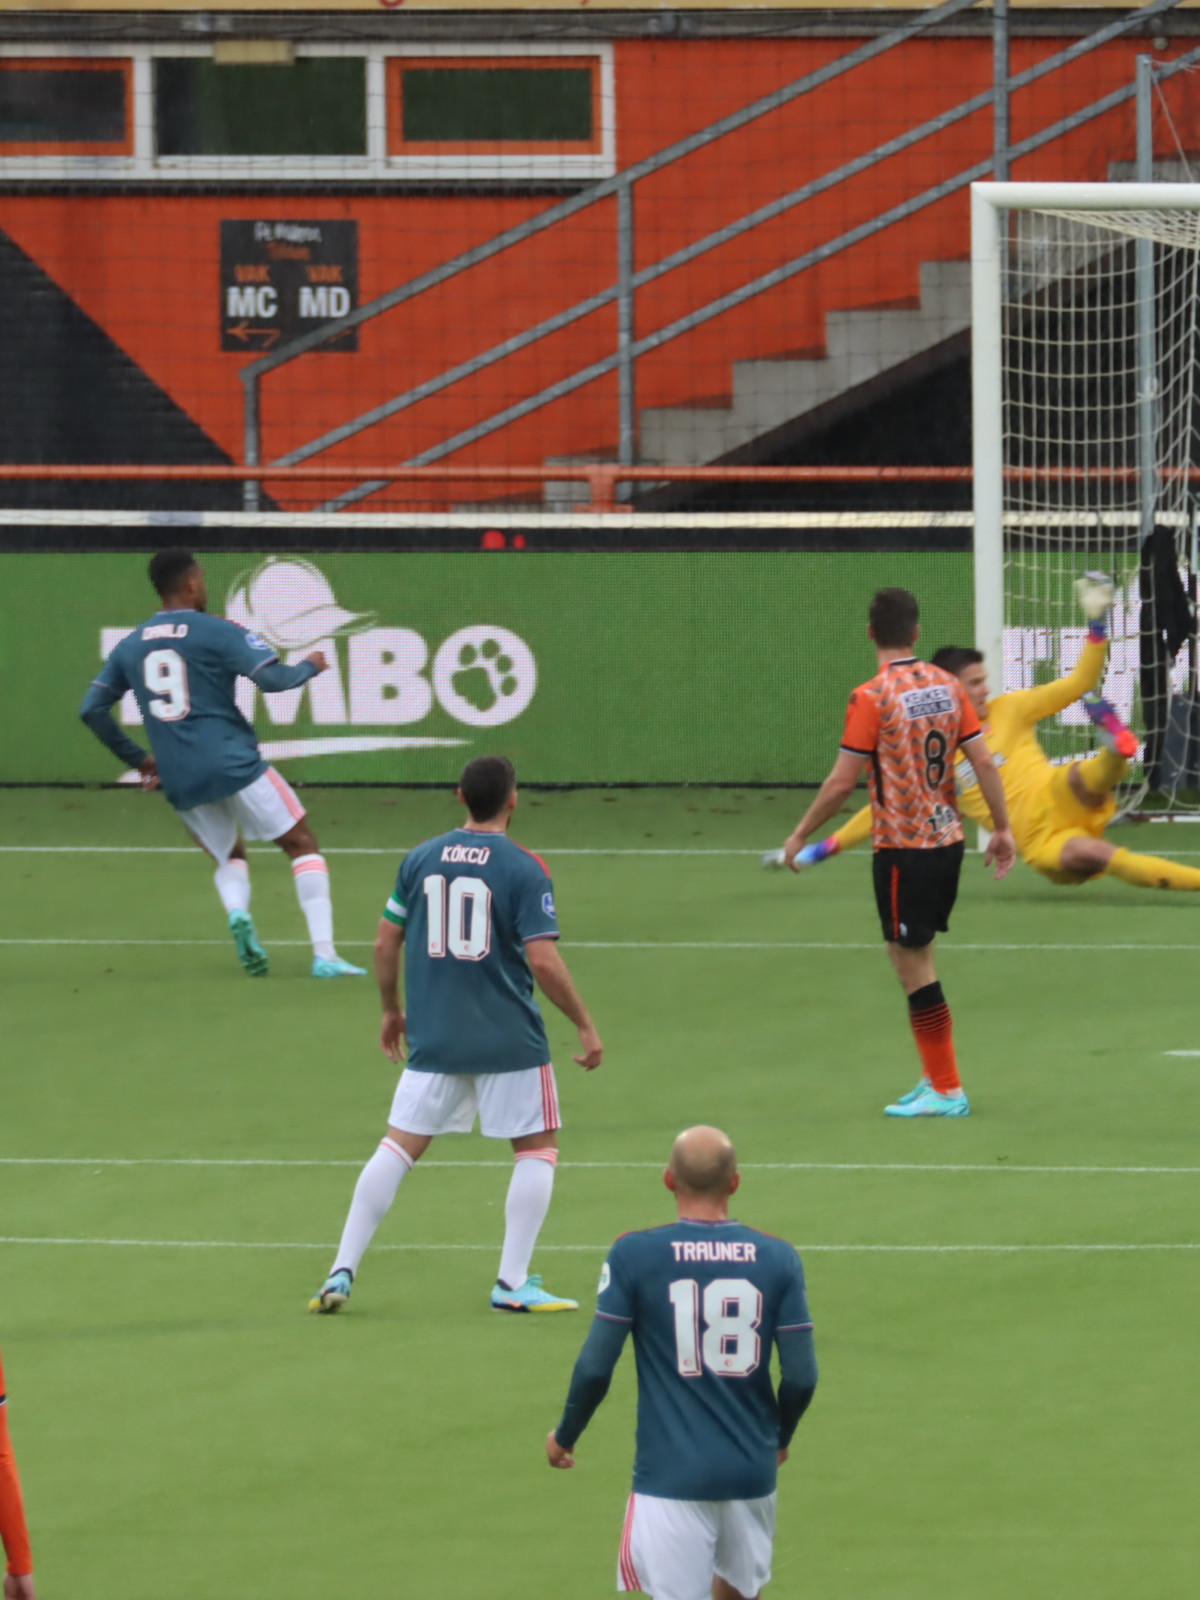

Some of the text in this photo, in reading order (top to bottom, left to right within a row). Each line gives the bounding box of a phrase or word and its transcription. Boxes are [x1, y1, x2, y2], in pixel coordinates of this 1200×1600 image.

[227, 286, 350, 318] MC MD
[100, 625, 537, 727] MBO
[144, 649, 190, 721] 9
[924, 729, 948, 792] 8
[424, 874, 492, 961] 10
[671, 1241, 757, 1262] TRAUNER
[669, 1278, 763, 1377] 18
